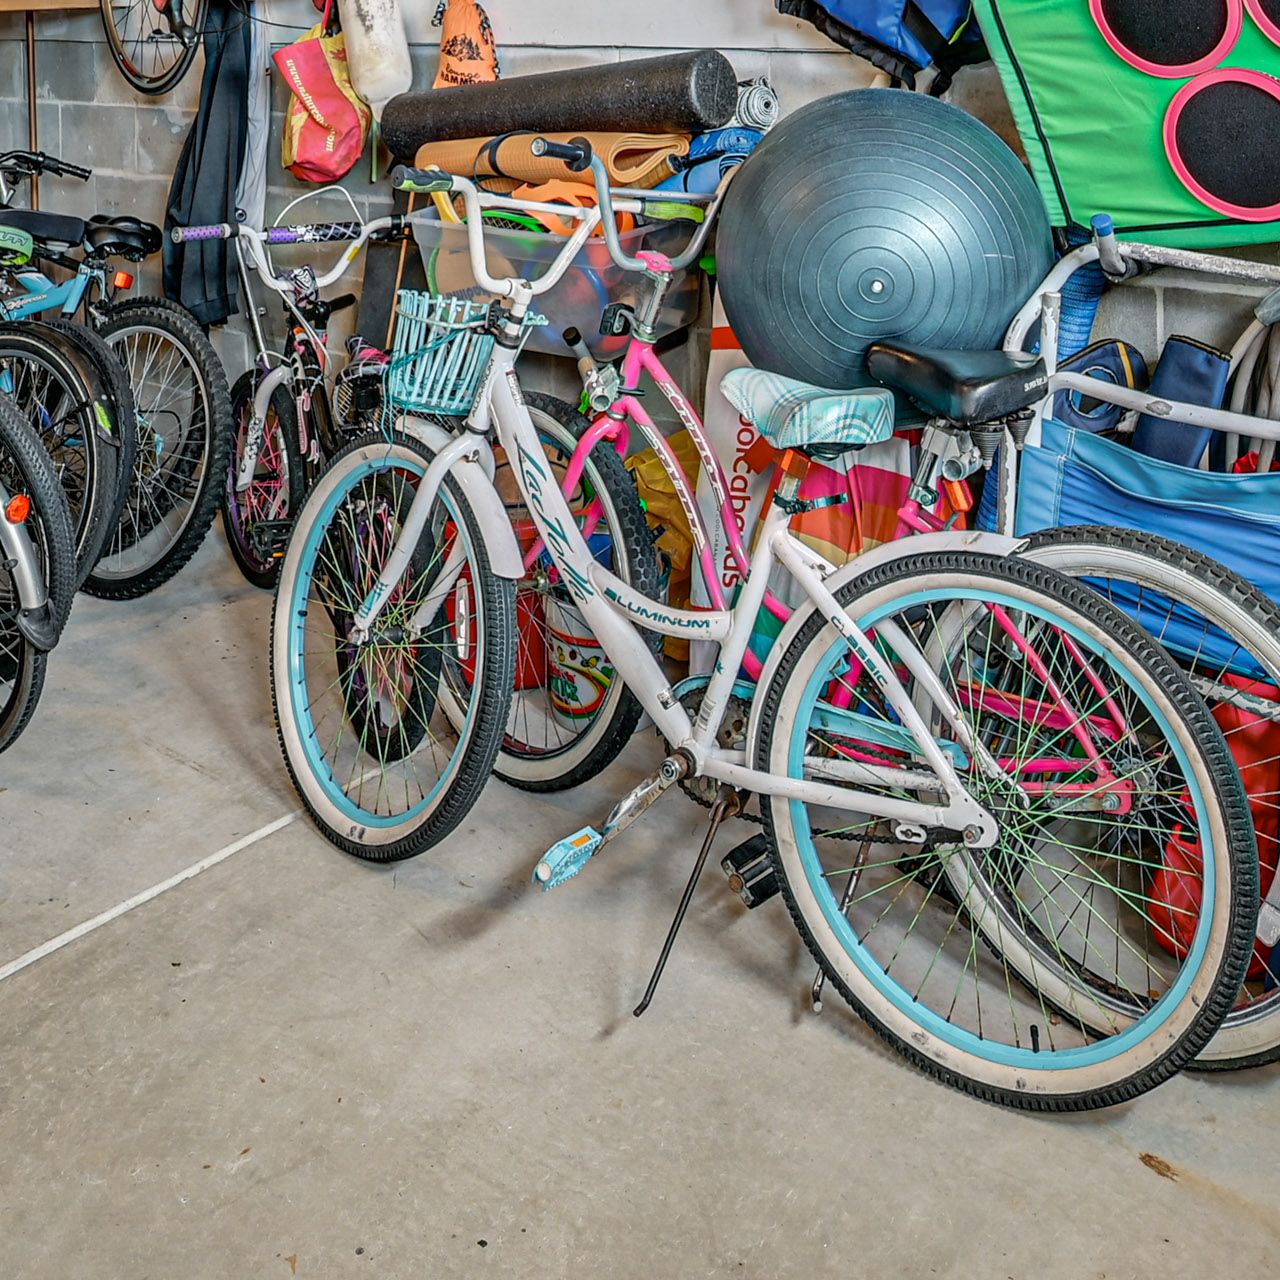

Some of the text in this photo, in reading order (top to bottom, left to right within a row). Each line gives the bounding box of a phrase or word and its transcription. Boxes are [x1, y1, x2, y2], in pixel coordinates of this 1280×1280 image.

[471, 357, 495, 418] ALUMINUM
[603, 586, 711, 630] ALUMINUM
[830, 615, 888, 688] CLASSIC
